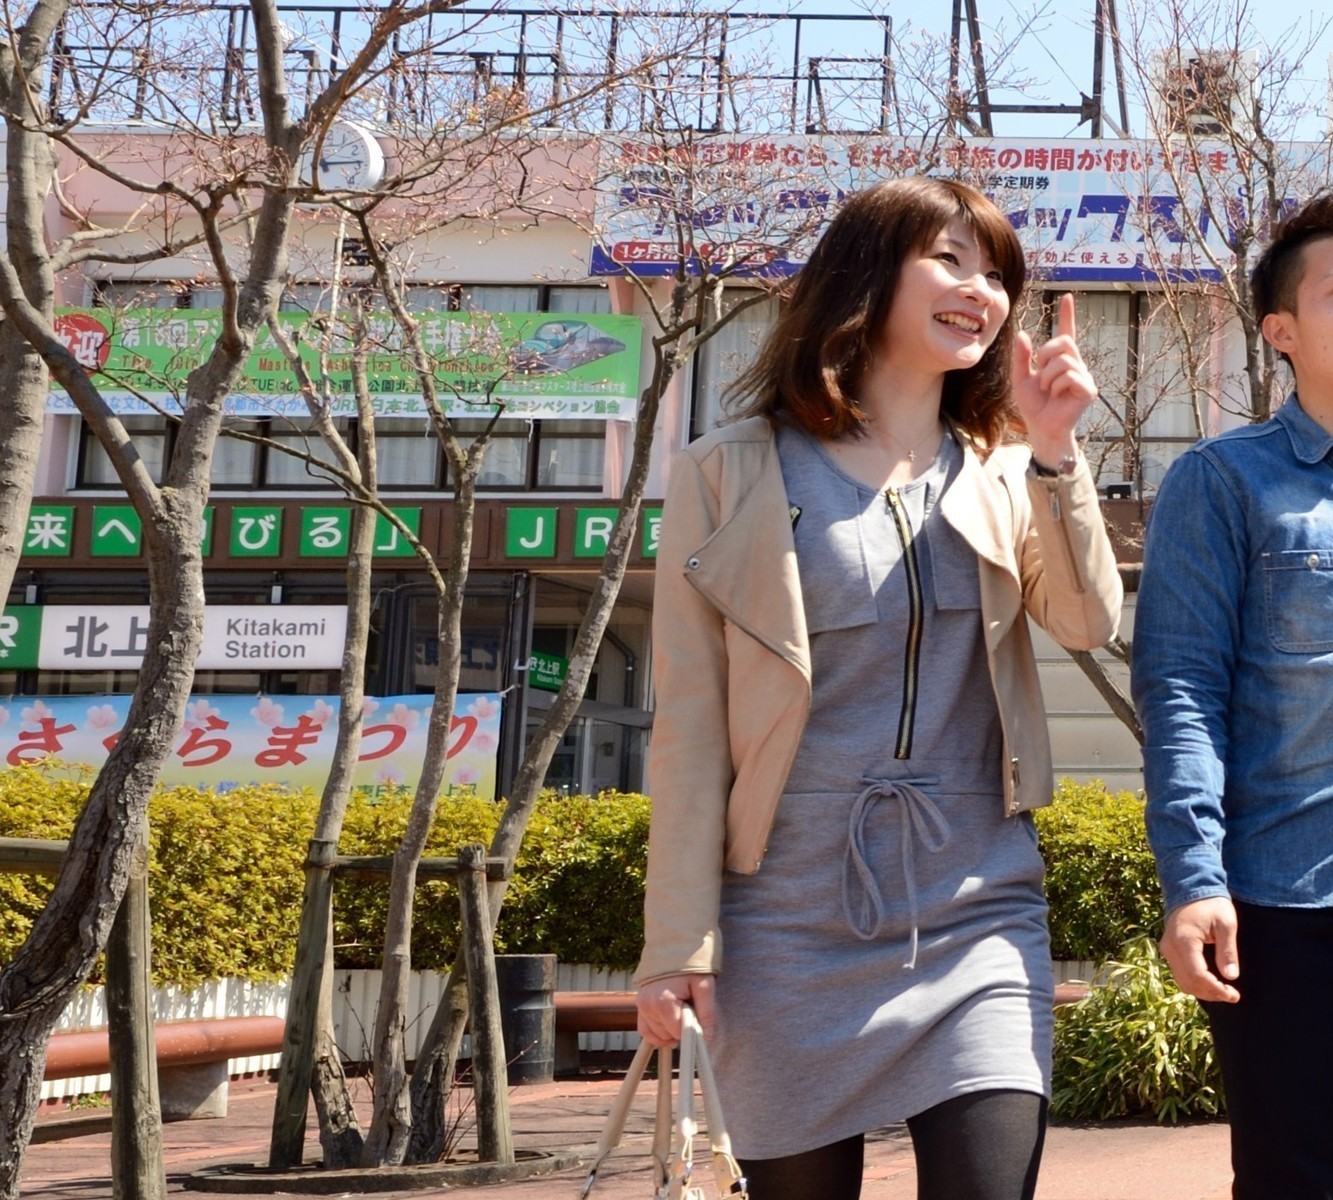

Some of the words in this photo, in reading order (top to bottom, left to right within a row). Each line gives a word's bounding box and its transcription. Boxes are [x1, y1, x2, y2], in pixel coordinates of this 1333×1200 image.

[27, 513, 405, 552] 来へびる」
[226, 618, 326, 637] Kitakami
[225, 640, 306, 659] Station
[6, 714, 479, 768] さらまつり
